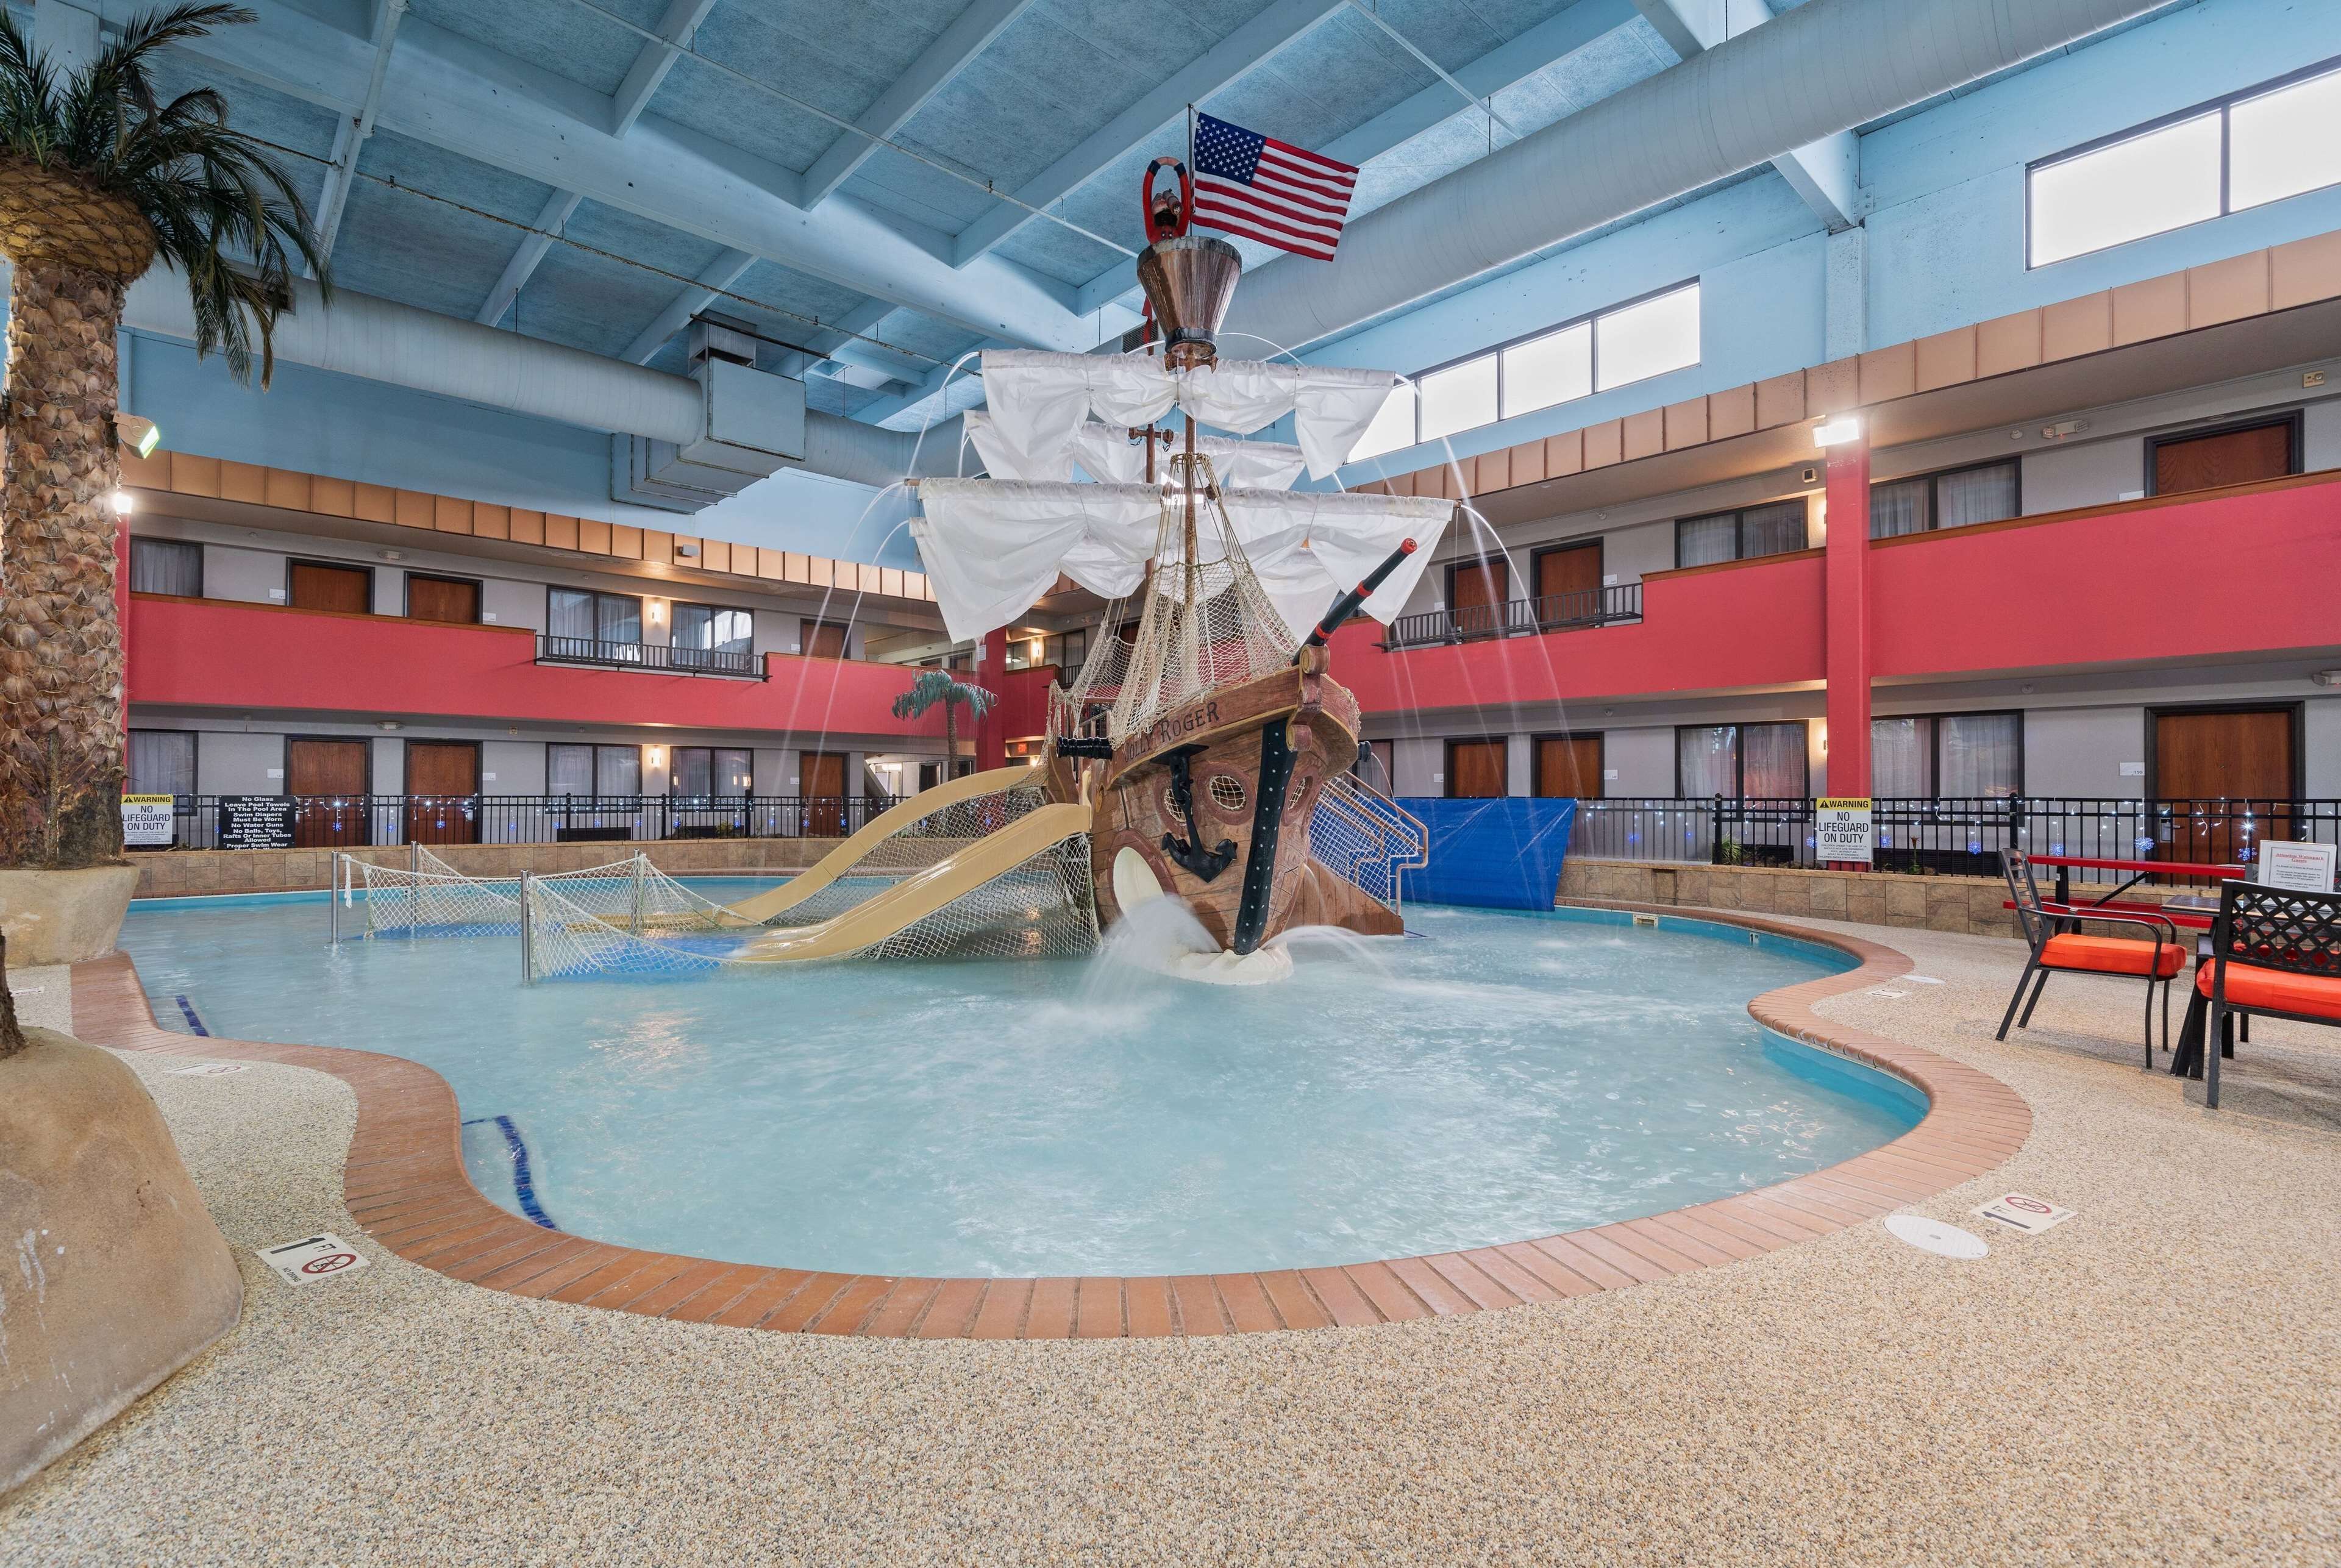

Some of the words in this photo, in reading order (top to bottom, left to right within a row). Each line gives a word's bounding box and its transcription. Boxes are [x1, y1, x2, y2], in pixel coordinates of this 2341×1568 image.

[1124, 731, 1153, 762] JOLLY
[1160, 702, 1220, 743] ROGER
[1837, 811, 1850, 821] NO
[1819, 822, 1869, 832] LIFEGUARD
[1824, 833, 1837, 843] ON
[1840, 833, 1864, 843] DUTY
[1982, 1211, 2032, 1230] 1
[269, 1237, 326, 1255] 1
[313, 1243, 337, 1252] FT
[287, 1271, 302, 1283] DIVING
